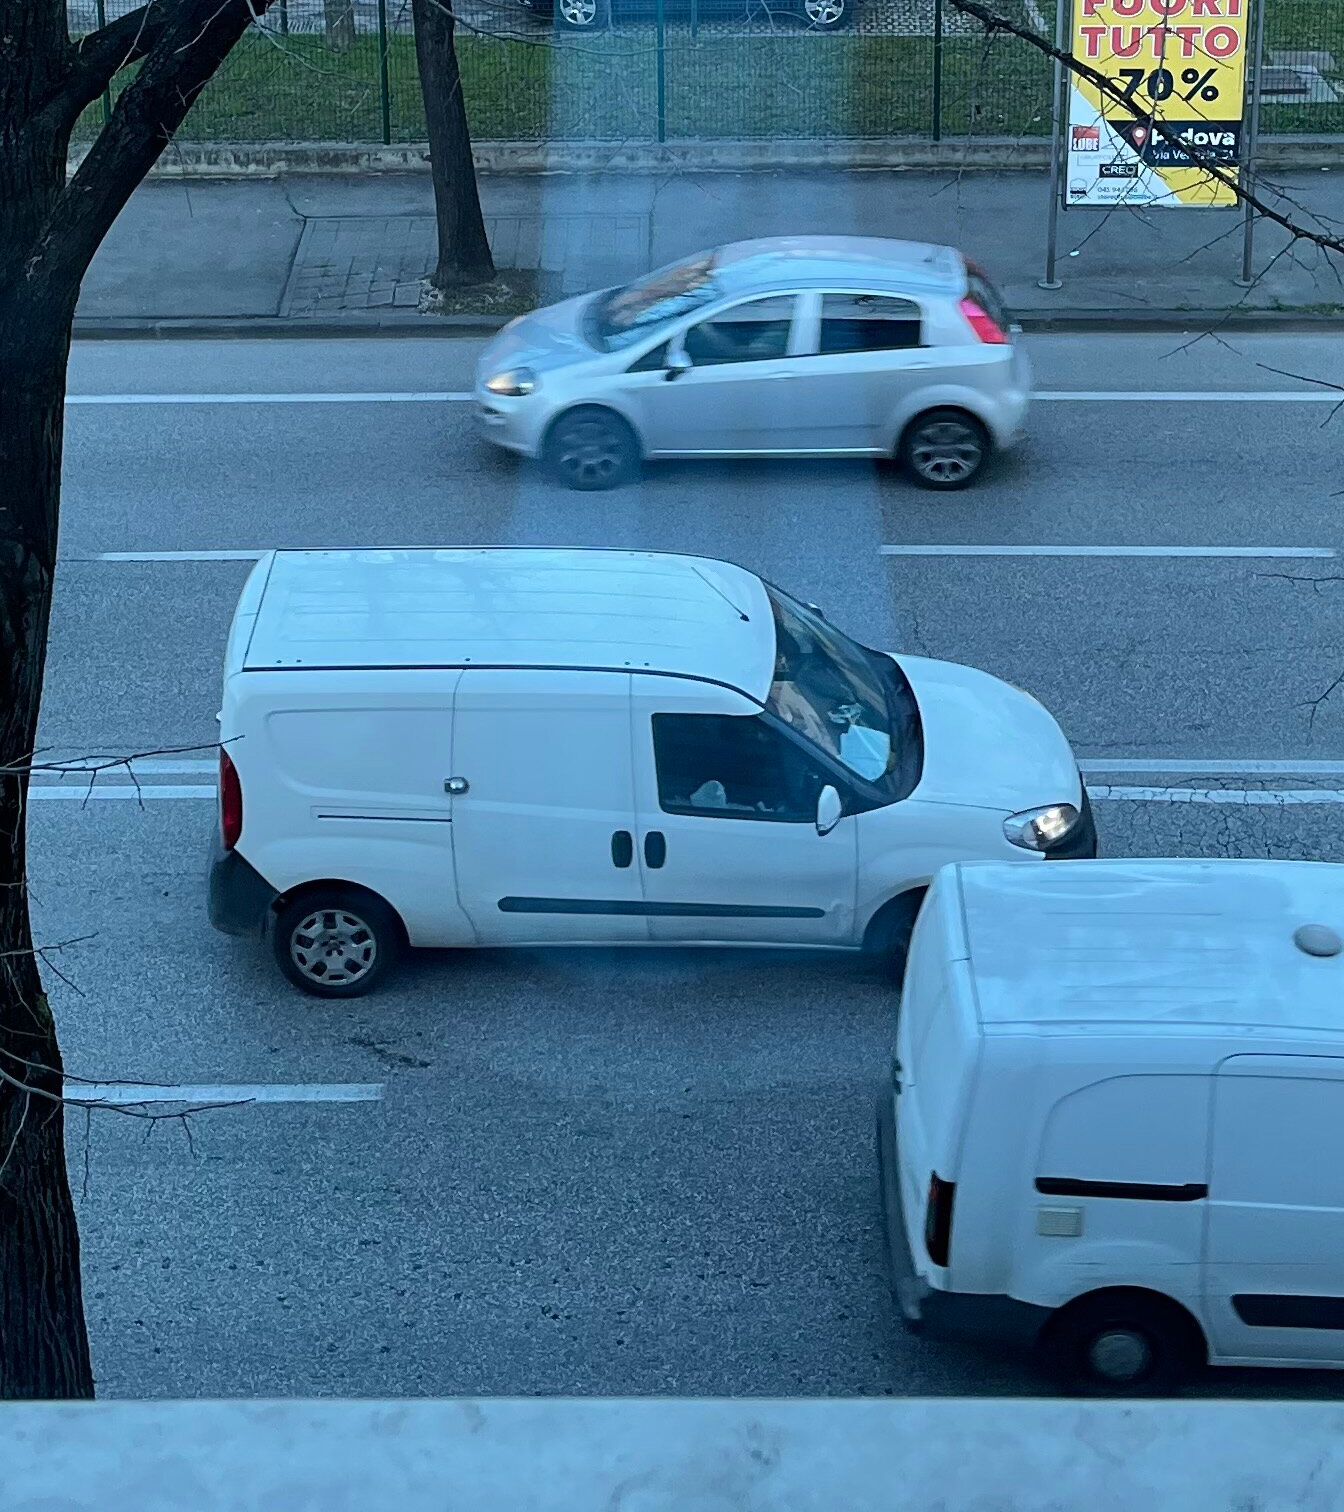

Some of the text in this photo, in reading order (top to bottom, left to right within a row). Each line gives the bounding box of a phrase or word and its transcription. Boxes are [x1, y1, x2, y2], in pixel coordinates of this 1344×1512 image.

[1081, 24, 1240, 60] TUTTO
[1119, 68, 1219, 101] 70%
[1151, 128, 1236, 146] Pdova
